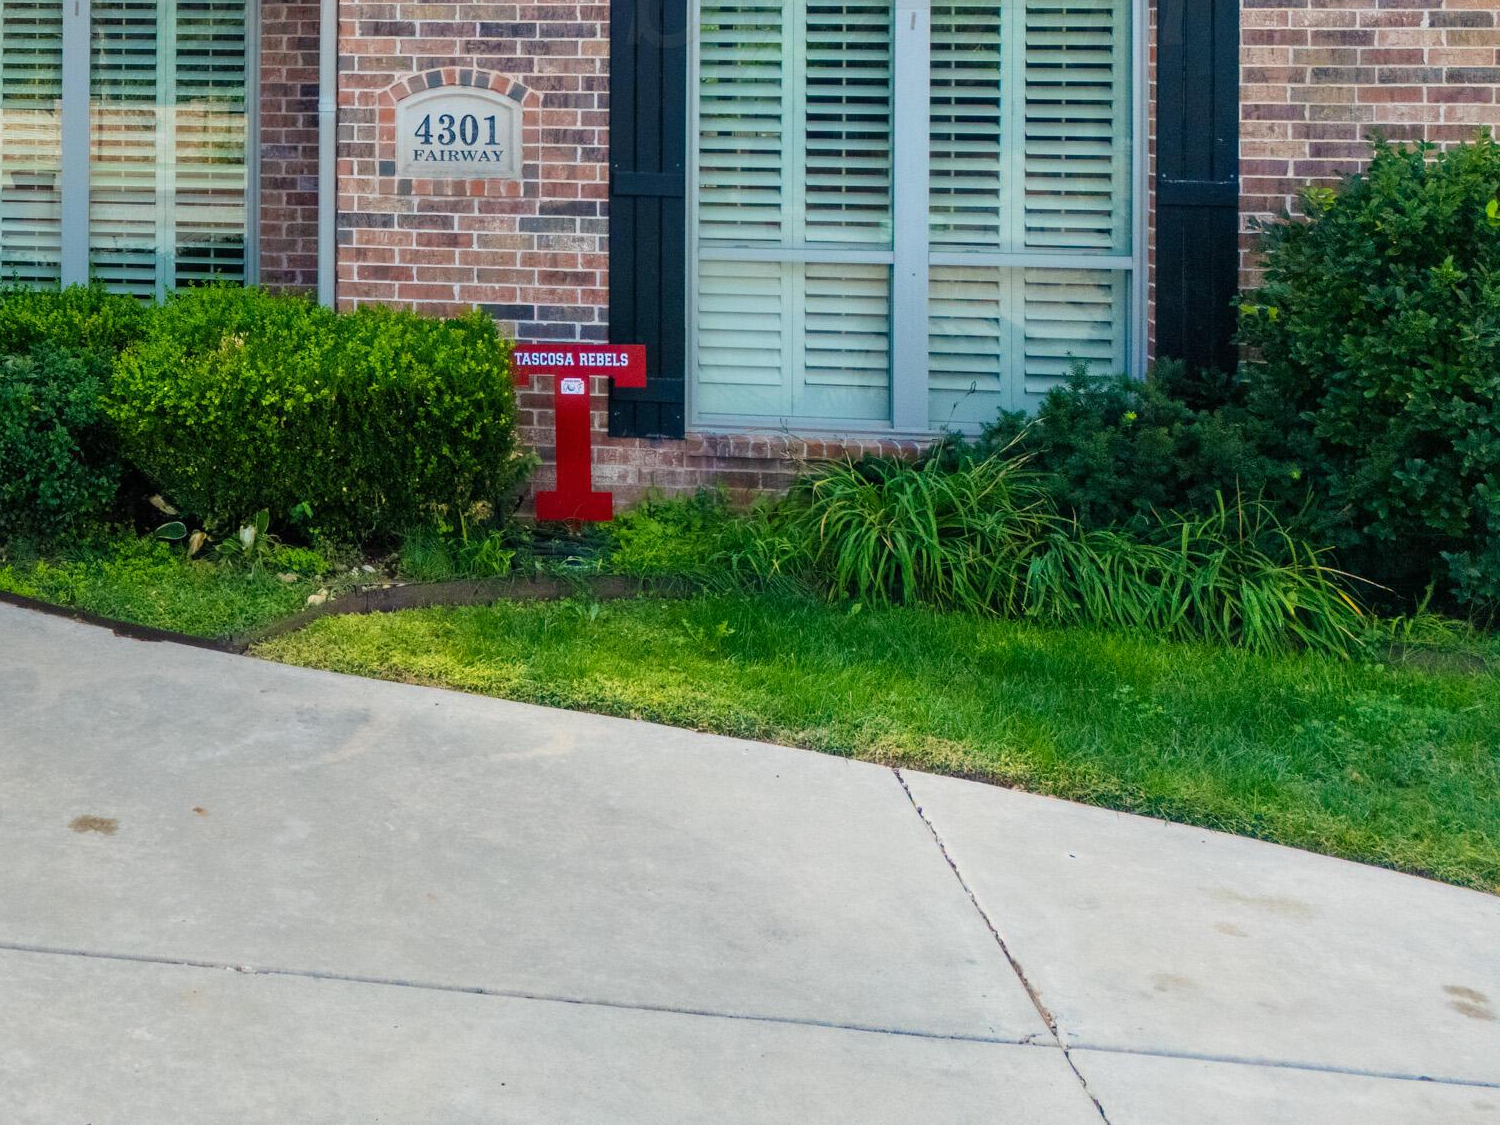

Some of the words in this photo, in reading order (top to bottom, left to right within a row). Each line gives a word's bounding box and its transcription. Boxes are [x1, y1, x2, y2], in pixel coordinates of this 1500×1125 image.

[414, 113, 500, 146] 4301
[412, 149, 504, 162] FAIRWAY
[514, 352, 574, 366] TASCOSA
[579, 353, 629, 367] REBELS
